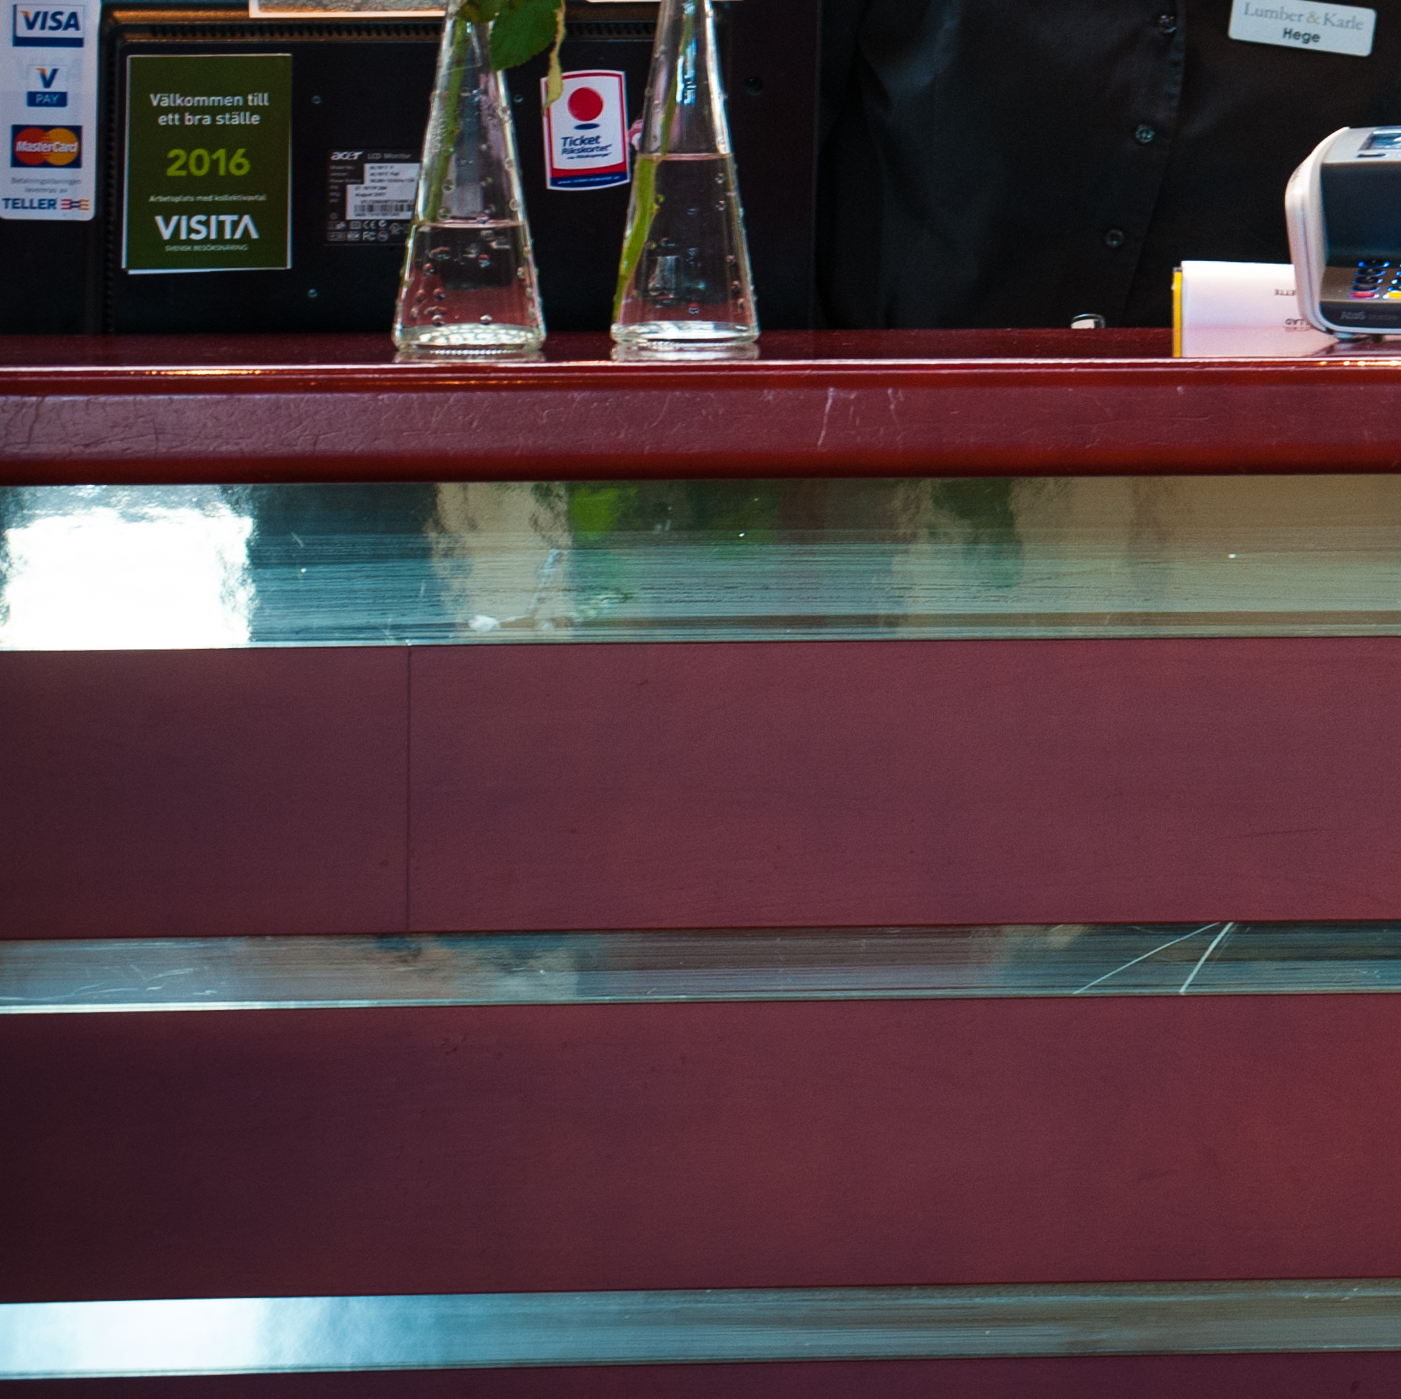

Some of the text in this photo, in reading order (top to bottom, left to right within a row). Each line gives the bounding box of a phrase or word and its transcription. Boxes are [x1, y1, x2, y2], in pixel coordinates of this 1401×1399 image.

[19, 10, 80, 31] VISA
[1243, 2, 1304, 23] Lumber
[1306, 11, 1321, 25] &
[1282, 28, 1321, 44] Hege
[35, 67, 59, 89] V
[35, 93, 60, 104] PAY
[150, 92, 270, 107] Välkommen till
[158, 111, 261, 125] ett bra ställe
[15, 140, 79, 153] MasterCard
[561, 135, 602, 147] Ticket
[166, 148, 251, 177] 2016
[330, 150, 364, 160] acer
[2, 198, 57, 210] TELLER
[154, 214, 260, 240] VISITA
